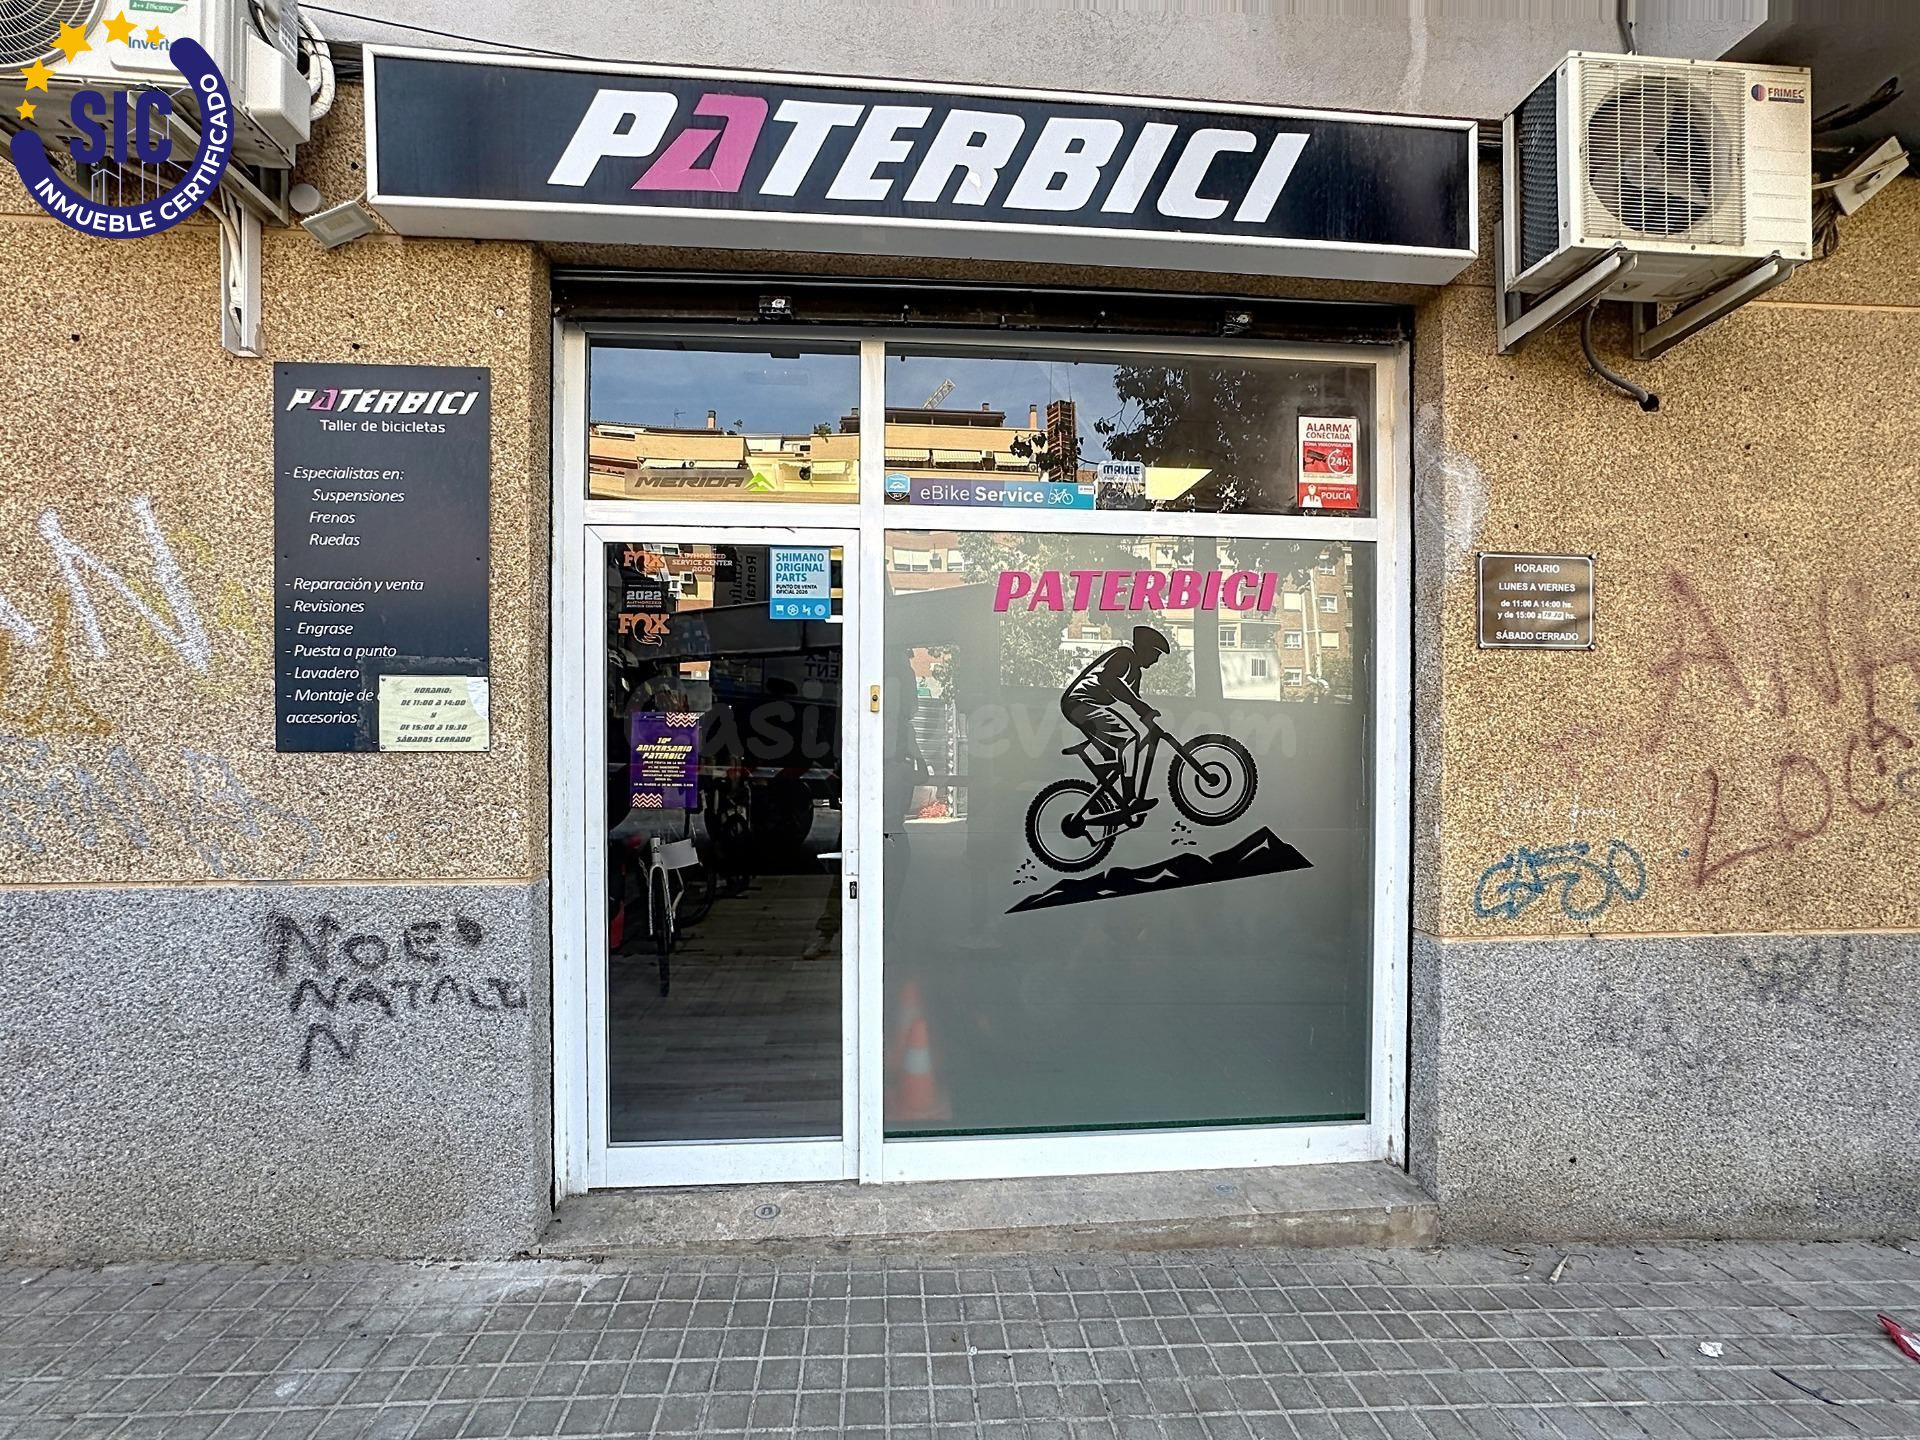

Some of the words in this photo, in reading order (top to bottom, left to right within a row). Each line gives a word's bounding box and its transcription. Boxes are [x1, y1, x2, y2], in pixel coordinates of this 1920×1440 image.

[1767, 87, 1805, 98] FRIMEC
[546, 88, 1310, 223] PATERBICI
[285, 388, 480, 415] PATERBICI
[320, 419, 357, 432] Taller
[361, 421, 377, 432] de
[381, 421, 446, 433] bicicletas
[1306, 423, 1350, 432] ALARMA
[1305, 432, 1351, 440] CONECTADA
[1330, 457, 1348, 466] 24h
[293, 466, 380, 481] Especialistas
[382, 469, 404, 481] en:
[1103, 464, 1140, 475] MAHLE
[634, 476, 745, 488] MERIDA
[312, 489, 405, 503] Suspensiones
[920, 485, 970, 501] eBike
[974, 486, 1044, 503] Service
[1321, 491, 1351, 500] POLICÍA
[309, 511, 356, 524] Frenos
[309, 533, 361, 546] Ruedas
[623, 550, 666, 571] FOX
[775, 552, 825, 562] SHIMANO
[775, 562, 825, 572] ORIGINAL
[1514, 563, 1560, 573] HORARIO
[775, 572, 808, 582] PARTS
[293, 577, 371, 592] Reparación
[373, 580, 384, 592] y
[385, 579, 424, 591] venta
[1498, 582, 1528, 591] LUNES
[1529, 583, 1537, 591] A
[1538, 583, 1576, 592] VIERNES
[626, 590, 662, 600] 2022
[993, 570, 1280, 612] PATERBICI
[293, 600, 365, 613] Revisiones
[1500, 600, 1511, 608] de
[1512, 600, 1532, 608] 11:00
[1497, 612, 1503, 620] y
[1504, 611, 1514, 619] de
[1515, 611, 1536, 619] 15:00
[297, 622, 354, 637] Engrase
[618, 612, 671, 641] FOX
[1495, 630, 1534, 640] SÁBADO
[1535, 632, 1579, 641] CERRADO
[294, 644, 341, 657] Puesta
[343, 647, 353, 657] a
[355, 645, 397, 660] punto
[294, 667, 360, 679] Lavadero
[295, 689, 354, 704] Montaje
[356, 689, 375, 701] de
[286, 711, 358, 724] accesorios
[395, 735, 433, 743] SÁBADOS
[636, 744, 693, 752] ANIVERSARIO
[642, 752, 686, 760] PATERBICI
